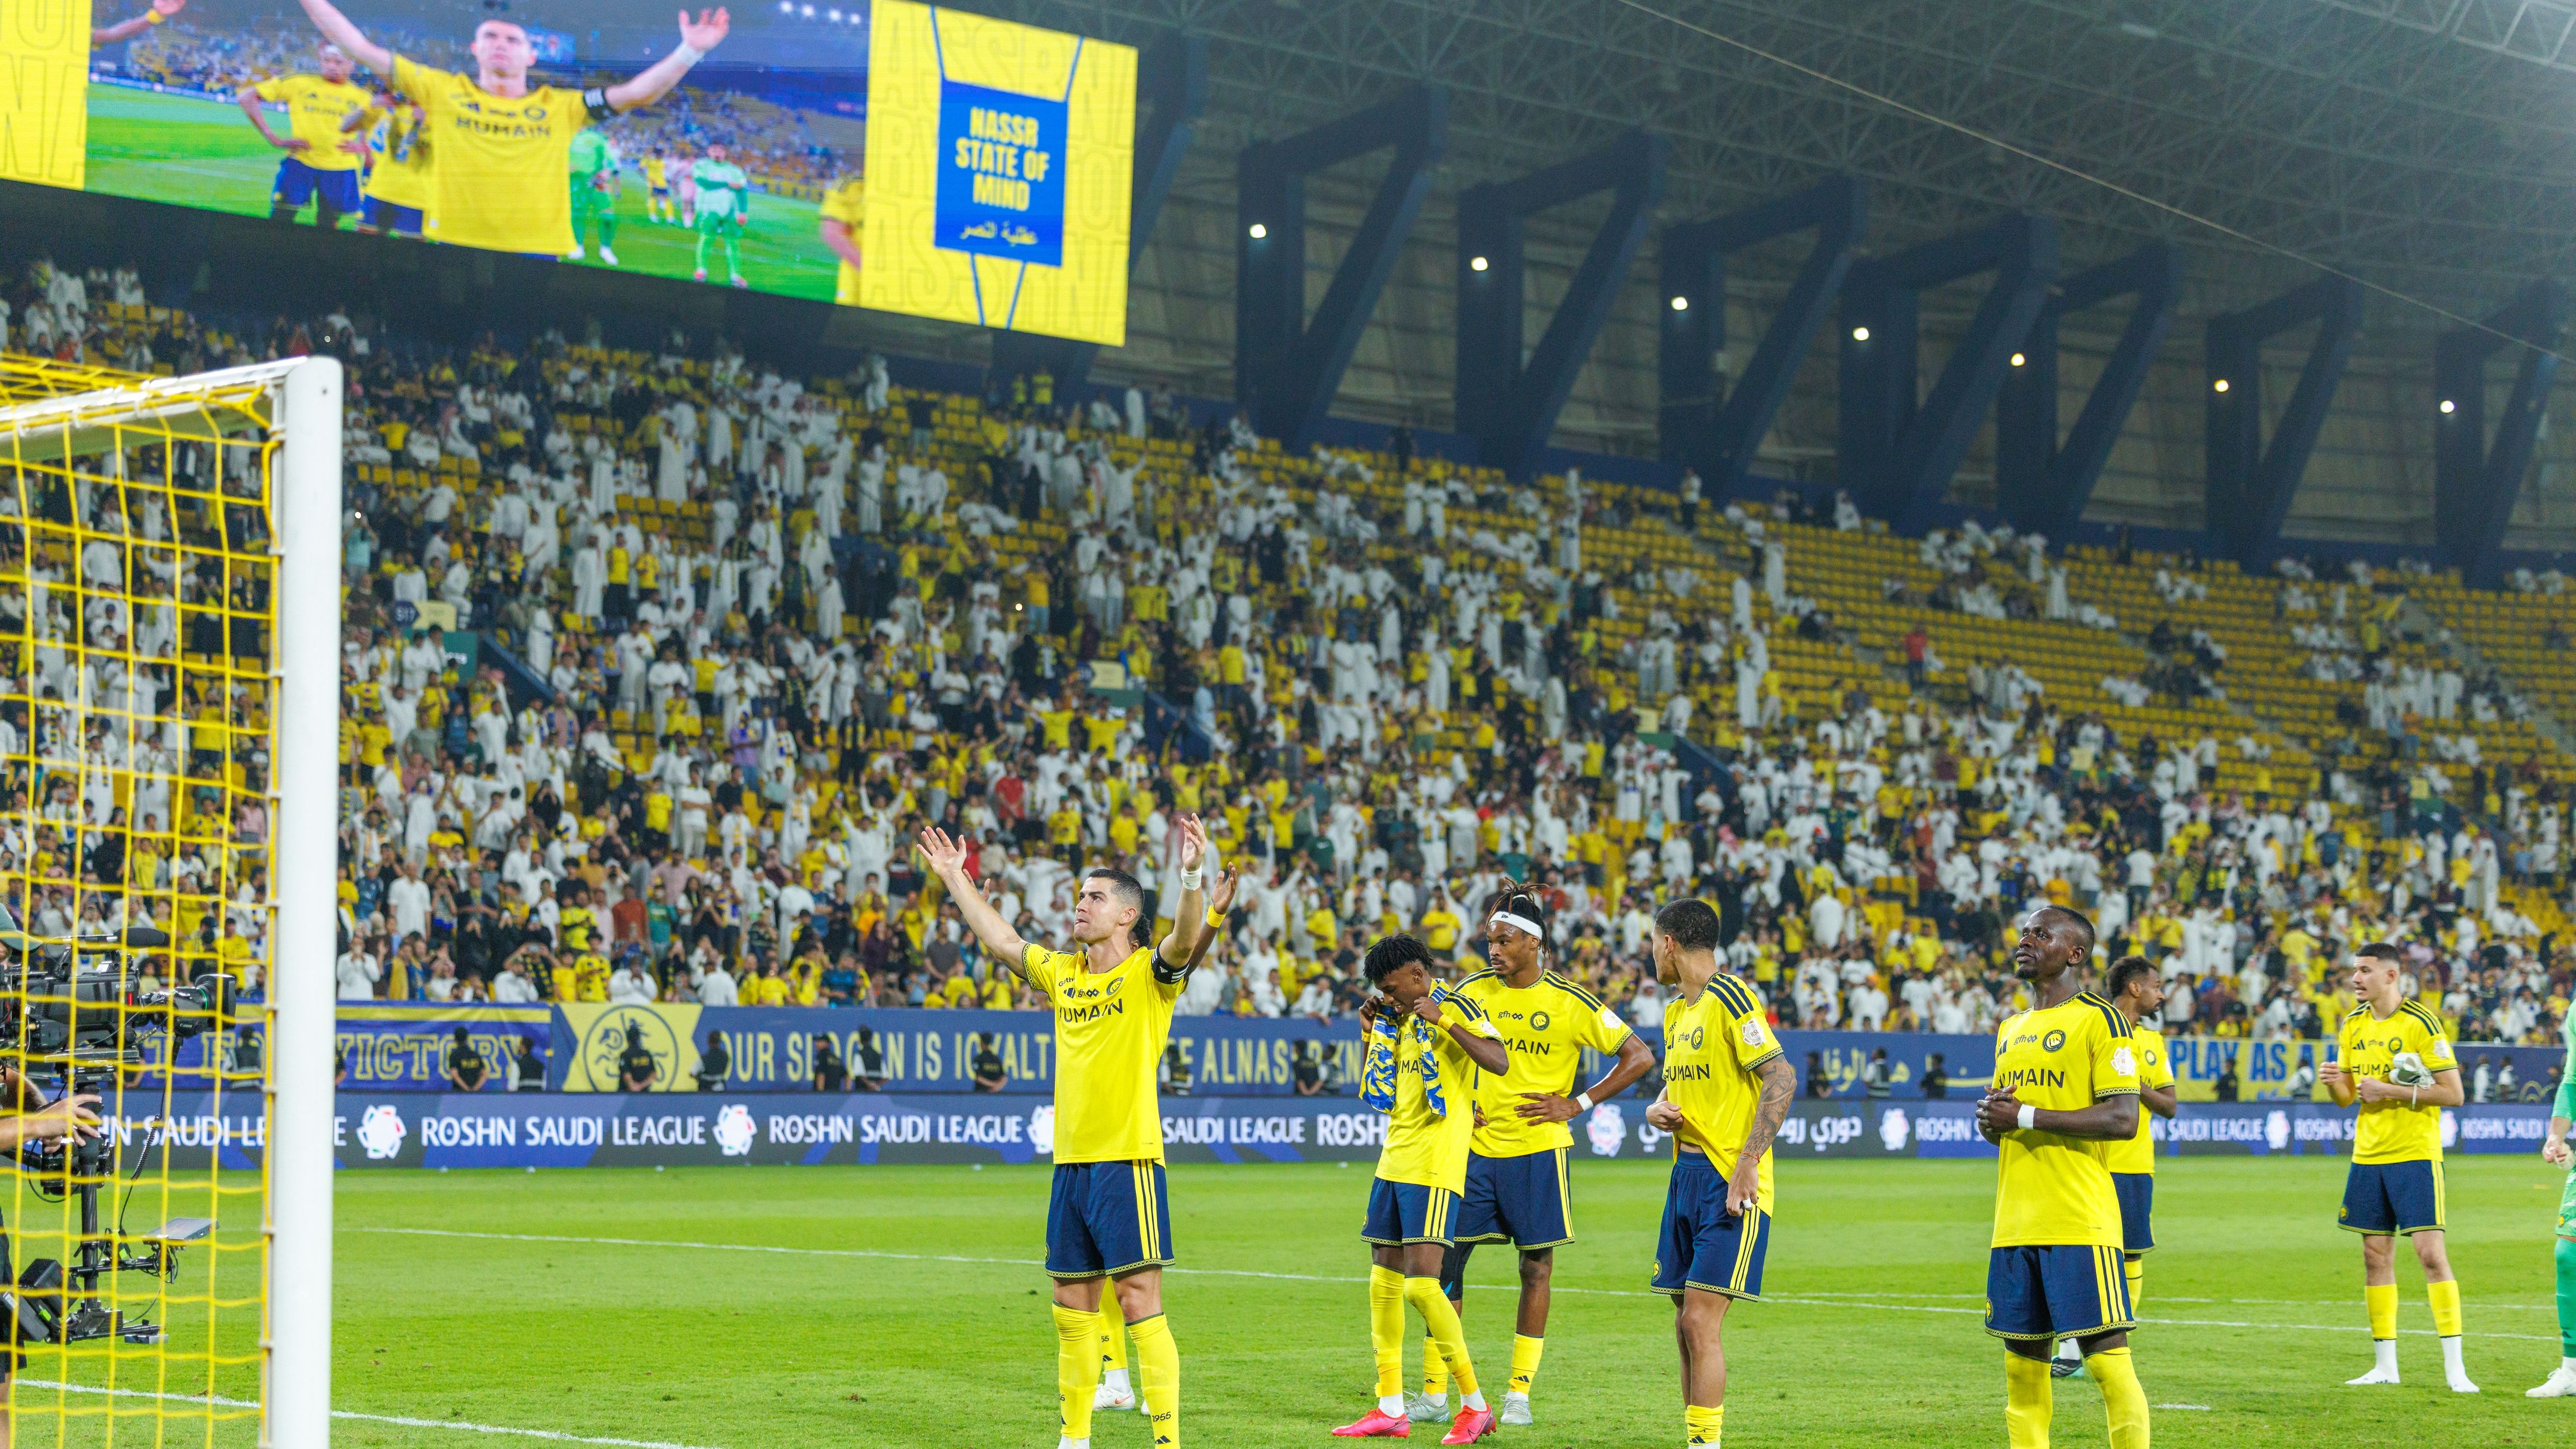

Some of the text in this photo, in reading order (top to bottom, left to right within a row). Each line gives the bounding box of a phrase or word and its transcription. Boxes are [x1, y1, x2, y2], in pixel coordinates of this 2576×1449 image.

[970, 106, 1039, 148] NASSR
[955, 136, 1051, 182] STATE OF
[973, 173, 1030, 212] MIND
[1060, 998, 1122, 1023] UMAIN
[1503, 1038, 1550, 1055] MAIN
[2014, 1034, 2027, 1045] gfh
[916, 1031, 942, 1081] IS
[2169, 1040, 2239, 1080] PLAY
[2249, 1042, 2286, 1081] AS
[2352, 1064, 2391, 1075] HUMA
[142, 1115, 230, 1147] SAUDI
[421, 1115, 706, 1148] ROSHN SAUDI LEAGUE
[769, 1114, 1023, 1144] ROSHN SAUDI LEAGUE
[1162, 1116, 1306, 1144] SAUDI LEAGUE
[1810, 1116, 1863, 1152] دوري
[1915, 1117, 1972, 1142] ROSHN
[2212, 1118, 2265, 1141] LEAGUE
[1152, 1411, 1171, 1422] 1955
